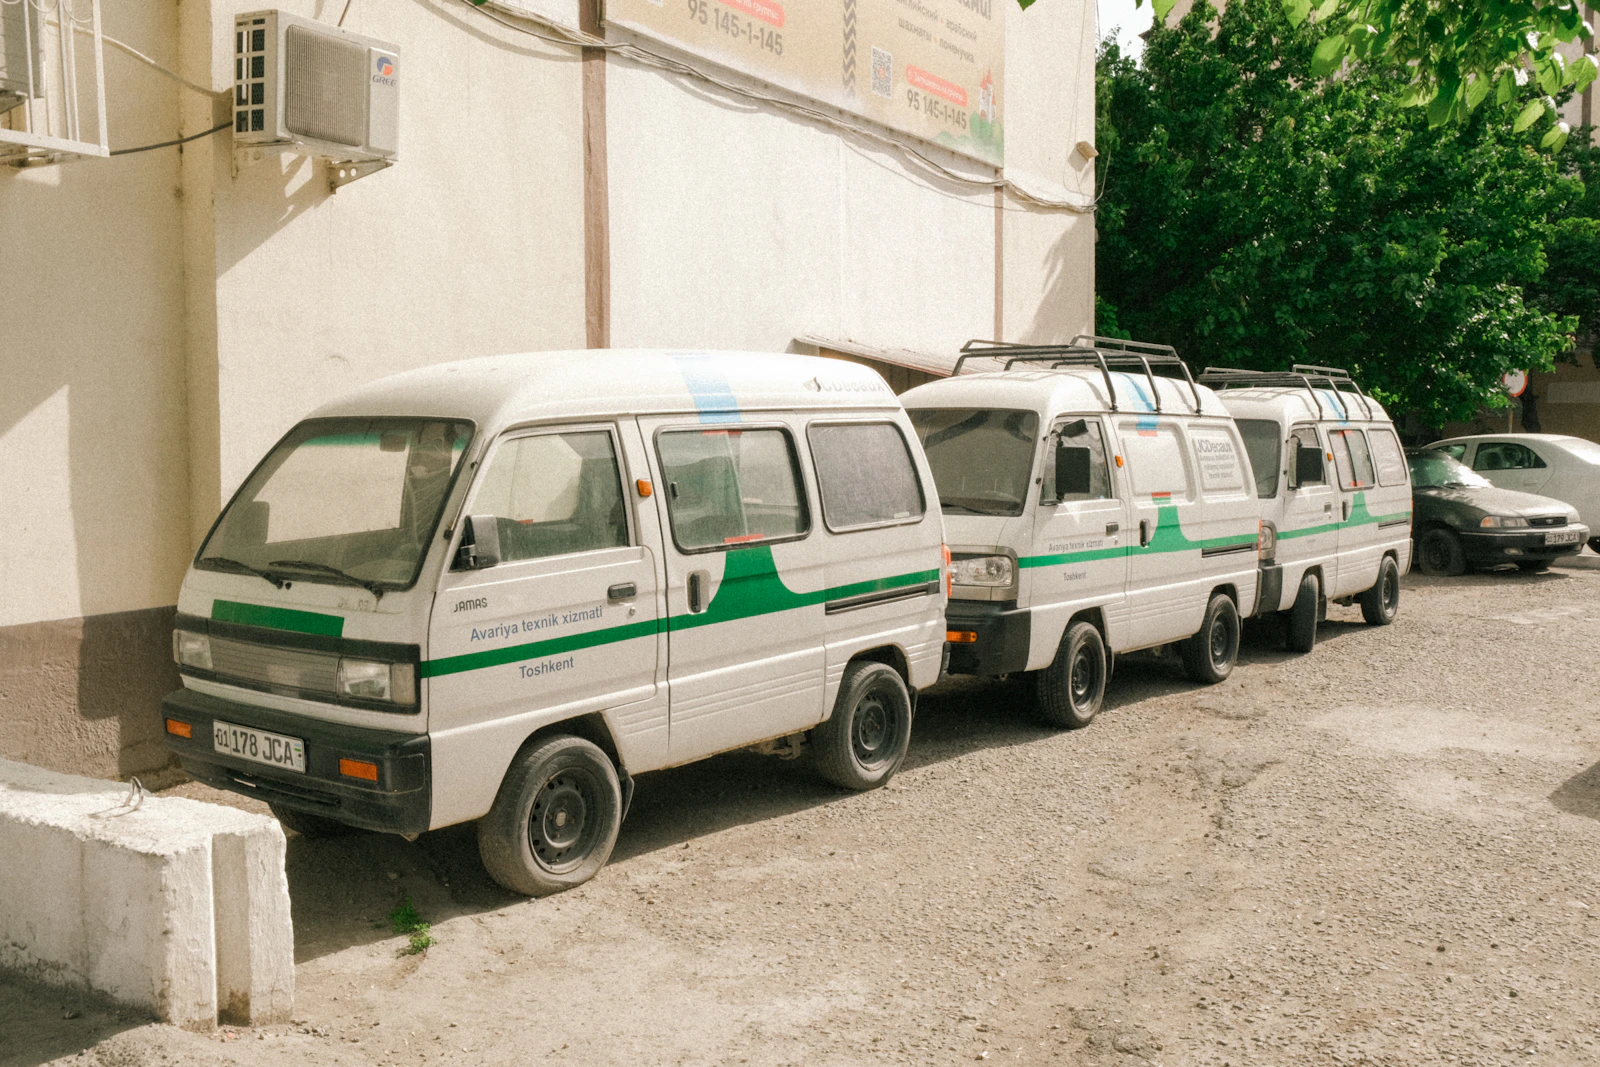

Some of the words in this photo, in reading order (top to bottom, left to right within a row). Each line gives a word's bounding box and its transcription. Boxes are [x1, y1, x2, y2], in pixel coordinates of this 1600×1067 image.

[687, 0, 708, 25] 95
[713, 8, 783, 56] 145-1-145
[898, 17, 932, 42] шахматы
[372, 74, 397, 87] GREE
[907, 88, 920, 111] 95
[922, 95, 967, 130] 145-1-145
[1048, 543, 1069, 552] Avariya
[470, 623, 519, 642] Avariya
[522, 614, 559, 632] texnik
[562, 605, 603, 625] xizmati
[519, 656, 574, 679] Toshkent
[232, 729, 258, 757] 178
[263, 736, 294, 766] JCA
